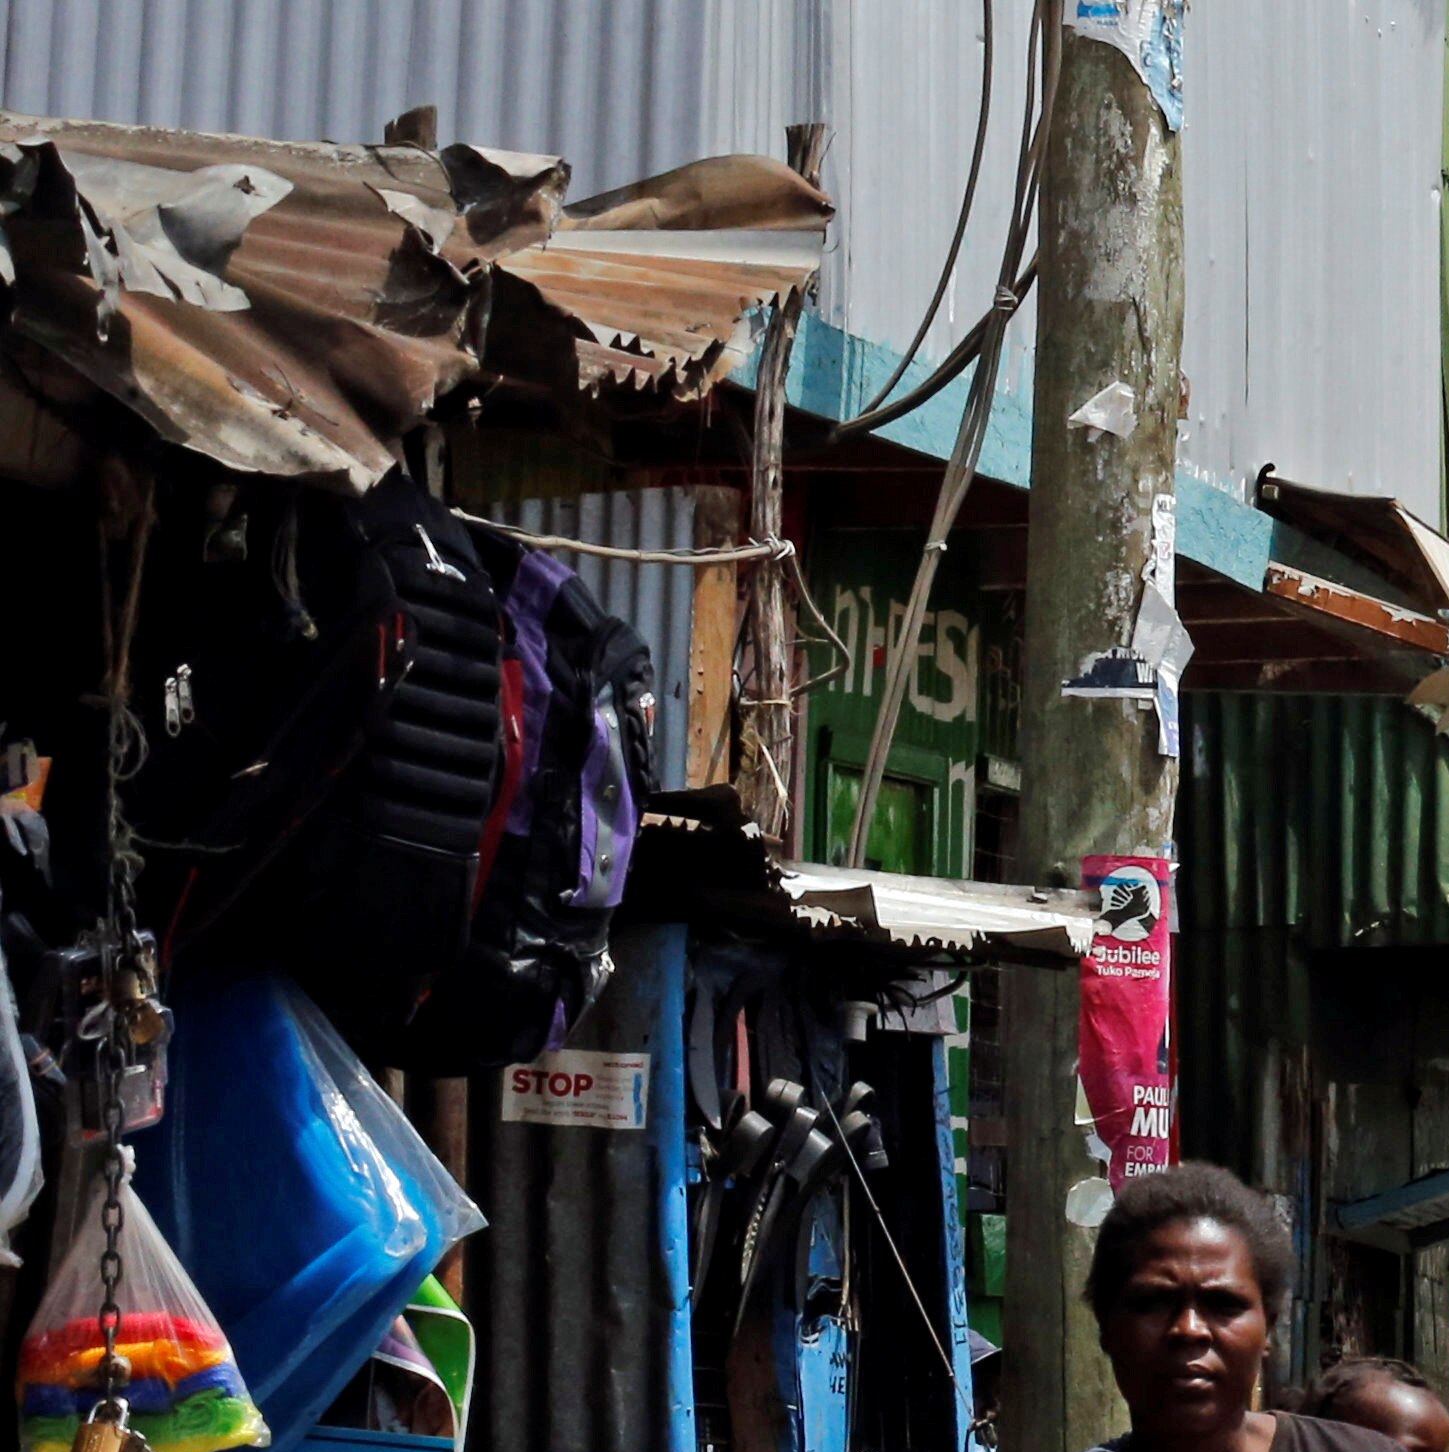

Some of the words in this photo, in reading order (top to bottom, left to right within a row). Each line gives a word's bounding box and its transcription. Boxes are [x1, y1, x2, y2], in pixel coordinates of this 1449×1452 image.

[1096, 965, 1123, 976] Tuko
[512, 1068, 593, 1098] STOP
[1126, 1145, 1153, 1161] FOR
